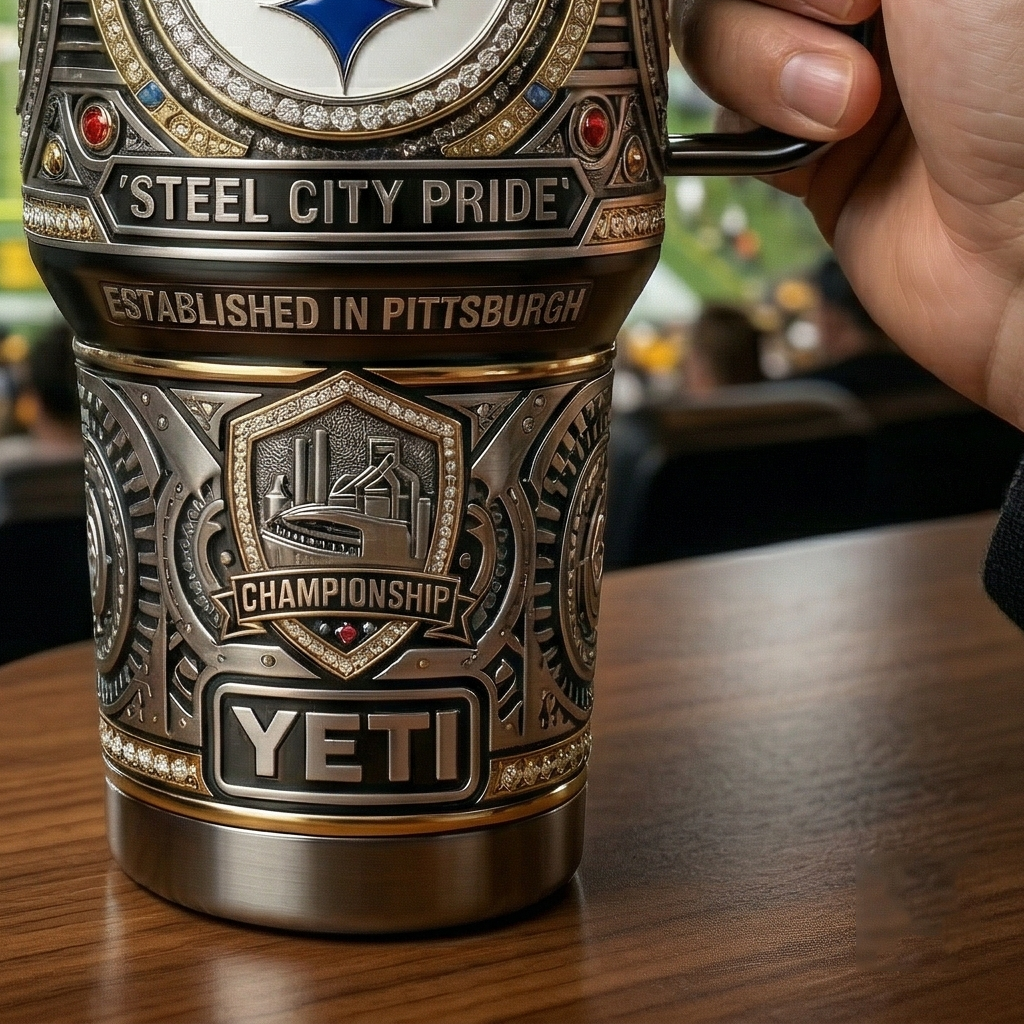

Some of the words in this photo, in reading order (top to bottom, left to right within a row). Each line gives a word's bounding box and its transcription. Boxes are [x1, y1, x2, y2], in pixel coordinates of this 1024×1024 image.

[289, 178, 405, 225] CITY
[108, 286, 320, 330] ESTABLISHED
[333, 296, 369, 332] IN
[383, 288, 584, 331] PITTSBURGH
[242, 576, 451, 616] CHAMPIONSHIP
[231, 705, 459, 784] YETI
